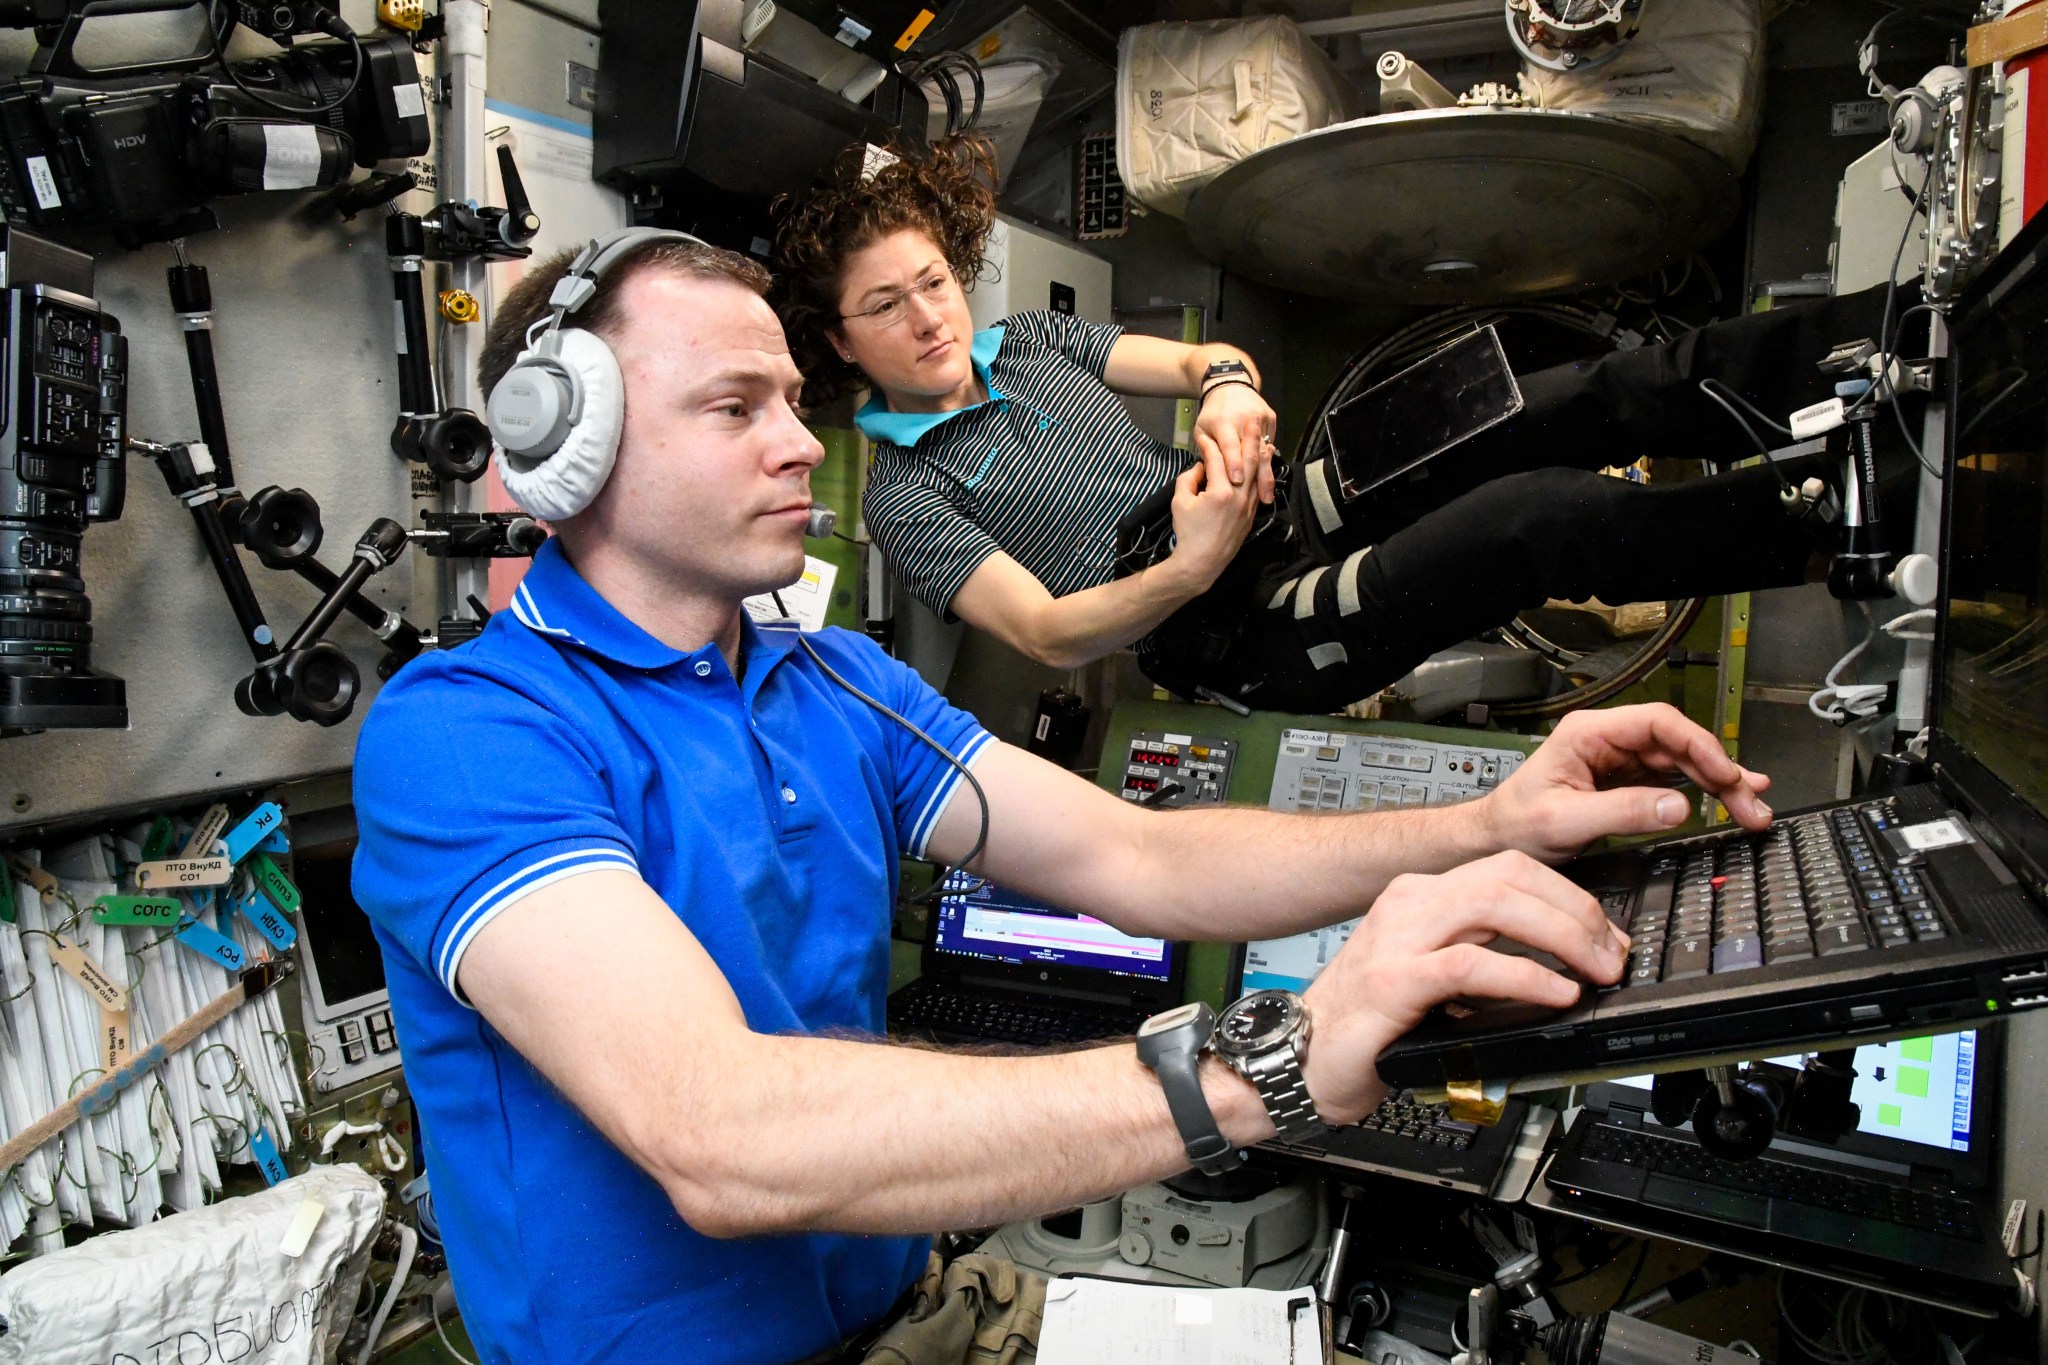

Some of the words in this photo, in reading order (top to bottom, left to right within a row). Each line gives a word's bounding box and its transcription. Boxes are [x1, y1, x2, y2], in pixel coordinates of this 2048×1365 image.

[1150, 90, 1163, 122] 1038
[114, 134, 147, 150] HDV
[1861, 422, 1876, 484] Manfrotto
[1380, 742, 1418, 751] EMERGENCY
[1310, 767, 1337, 775] WARNING
[1379, 775, 1410, 783] LOCATION
[1451, 782, 1479, 790] CAUTION
[255, 812, 273, 829] РК
[195, 832, 205, 846] ПТО
[165, 863, 187, 872] ПТО
[190, 861, 222, 872] ВнуКД
[180, 873, 200, 882] СО1
[132, 904, 171, 917] СОГС
[260, 912, 285, 939] СУДН
[216, 945, 241, 964] РСУ
[99, 988, 112, 1004] ПТО
[107, 987, 119, 998] СМ
[118, 1038, 125, 1051] СМ
[1607, 1036, 1632, 1047] DVD
